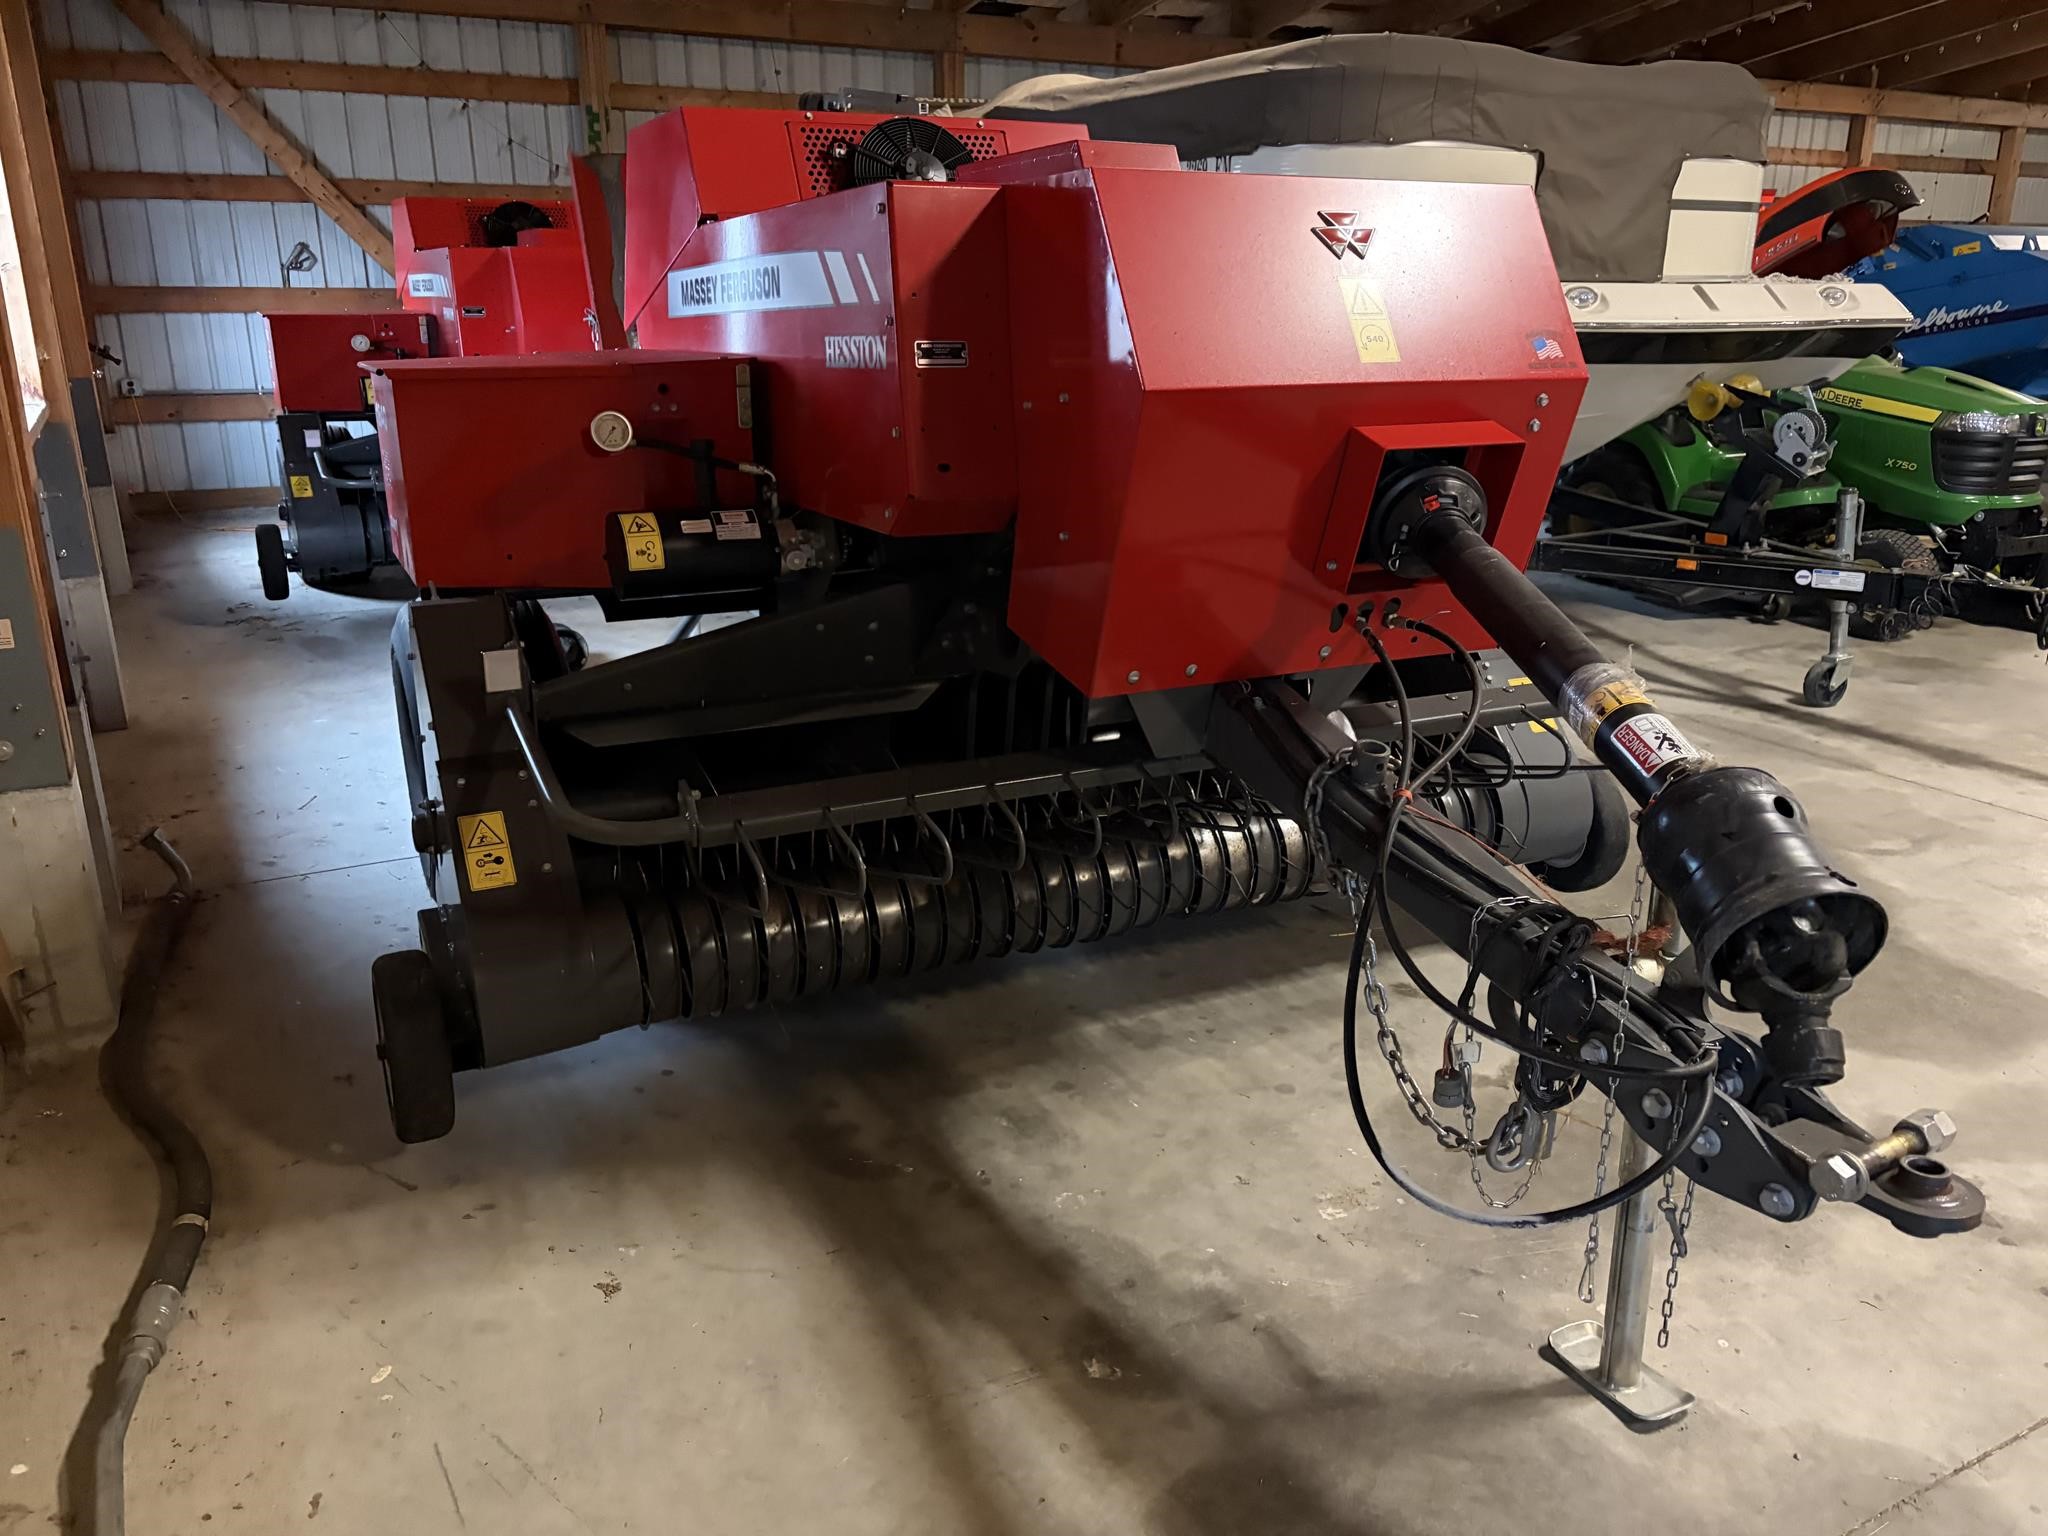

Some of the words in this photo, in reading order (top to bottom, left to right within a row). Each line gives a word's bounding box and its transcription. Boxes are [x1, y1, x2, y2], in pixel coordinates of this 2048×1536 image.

[681, 276, 717, 307] MASSEY
[720, 265, 781, 300] FERGUSON
[1896, 300, 2009, 337] elbourne
[1924, 316, 1989, 334] REYNOLDS
[824, 335, 887, 369] HESSTON
[1366, 335, 1384, 343] 540
[1827, 389, 1863, 409] DEERE
[1885, 457, 1918, 471] X750
[1617, 726, 1652, 761] DANGER
